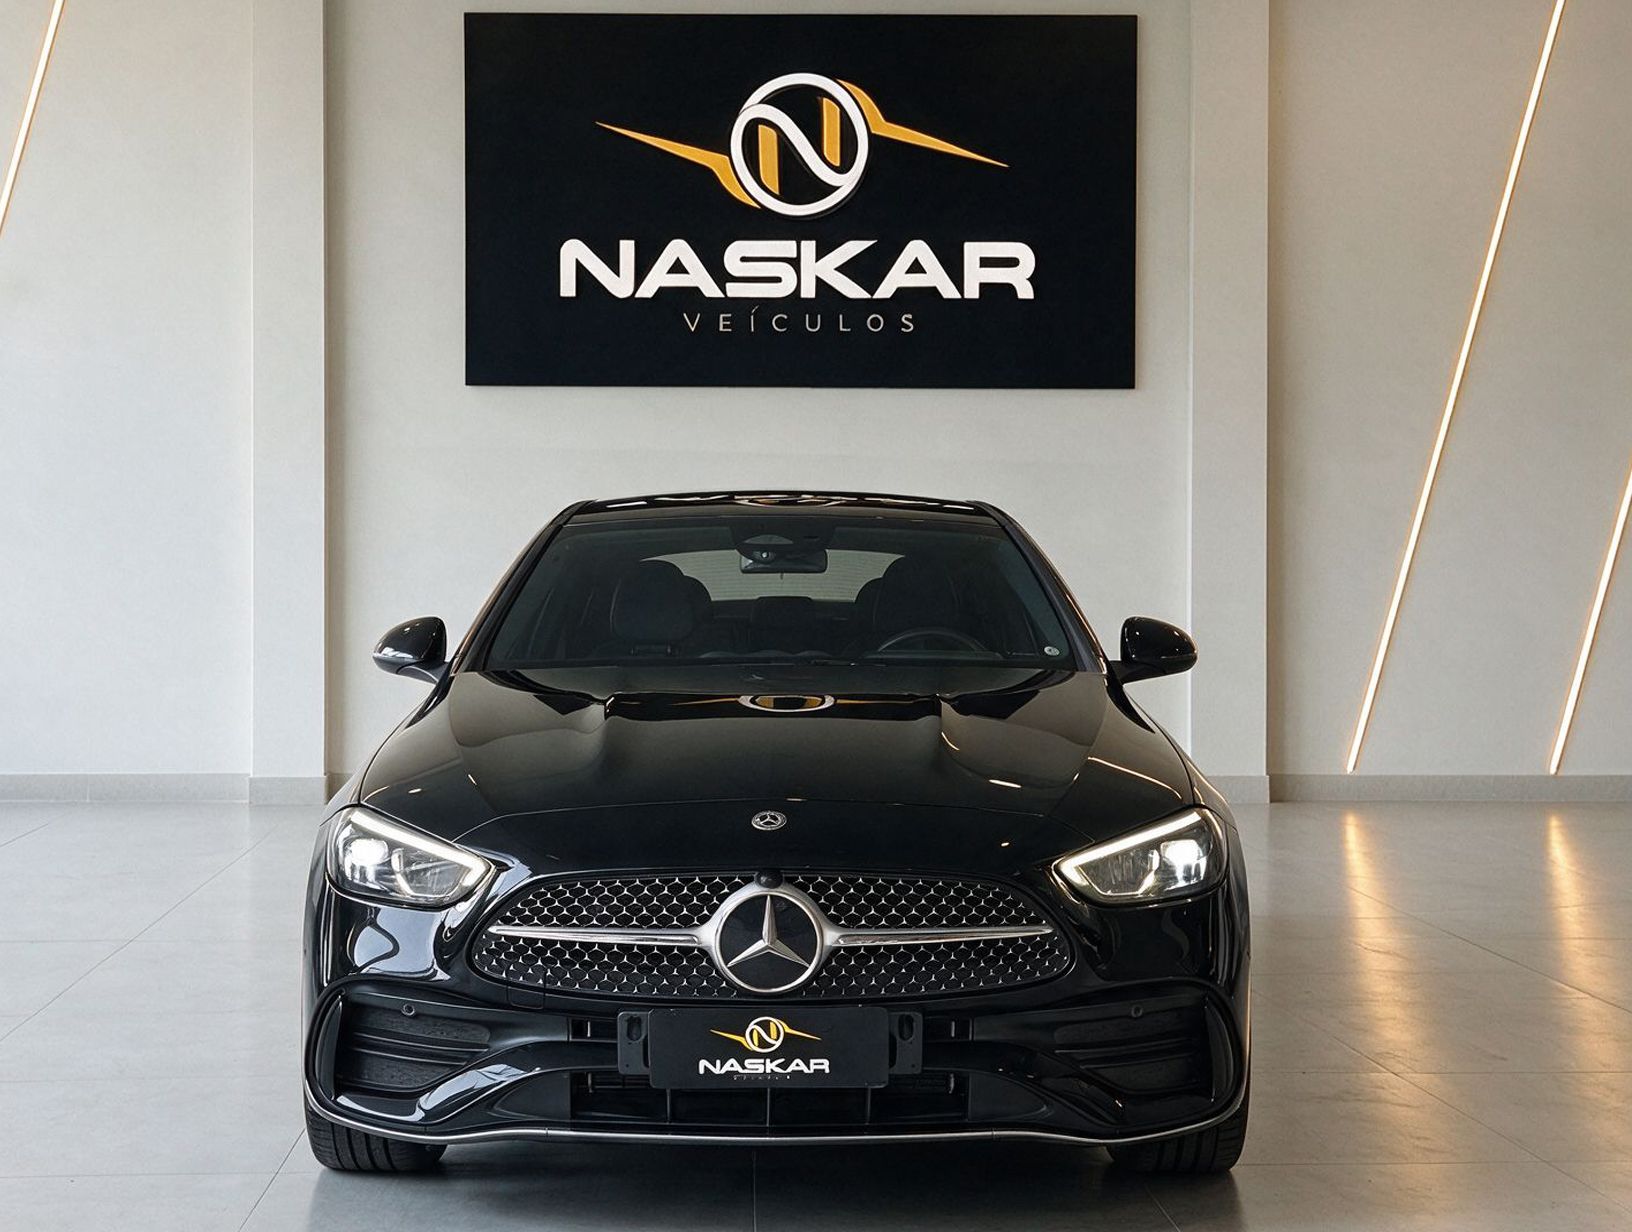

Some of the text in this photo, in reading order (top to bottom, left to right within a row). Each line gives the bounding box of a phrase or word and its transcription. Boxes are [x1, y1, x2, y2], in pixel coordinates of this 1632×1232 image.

[560, 239, 1036, 299] NASKAR
[683, 306, 914, 333] VEÍCULOS
[698, 1058, 830, 1074] NASKAR
